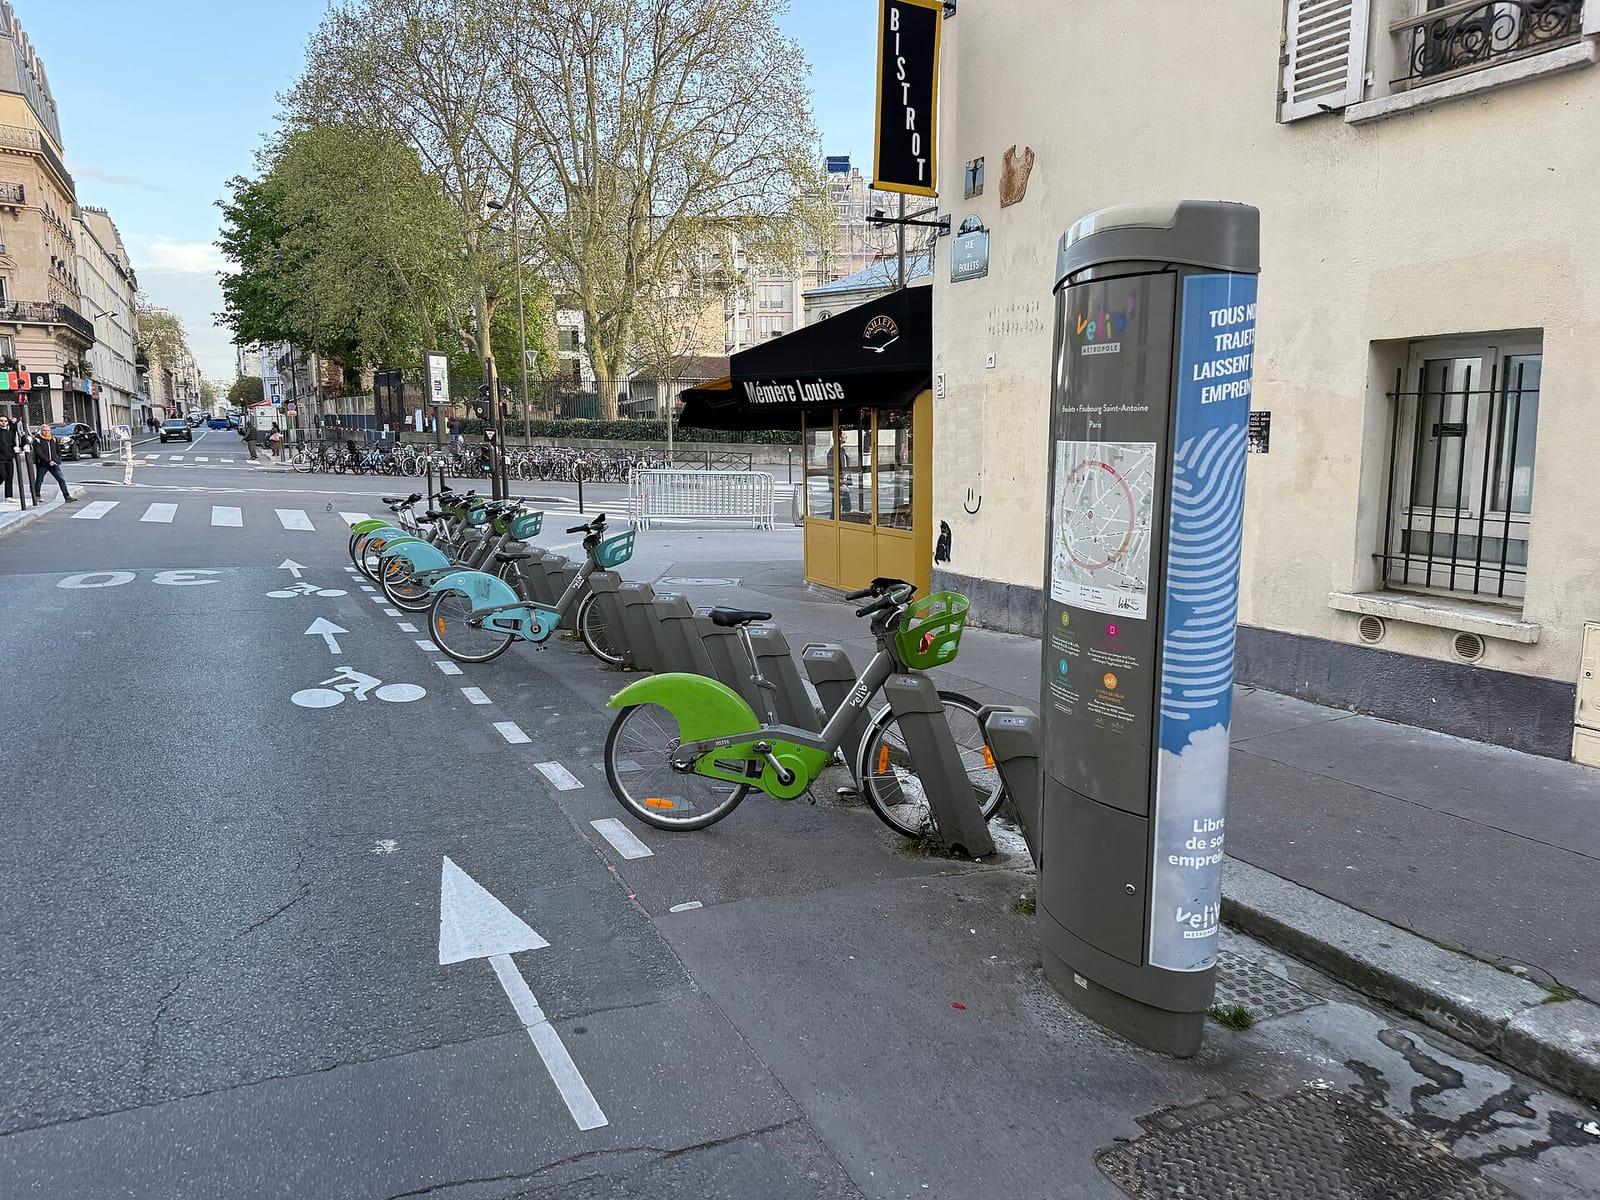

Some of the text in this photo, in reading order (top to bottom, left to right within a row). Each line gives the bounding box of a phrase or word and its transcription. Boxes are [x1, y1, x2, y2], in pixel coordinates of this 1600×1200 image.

[890, 7, 926, 181] BISTROT
[958, 260, 980, 273] BOULETS
[1209, 305, 1245, 328] TOUS
[1192, 354, 1250, 381] LAISSENT
[743, 378, 845, 404] Mémère Louise
[1079, 404, 1102, 415] Faubourg
[1102, 403, 1149, 413] Saint-Antoine
[1089, 420, 1102, 429] Paris
[1185, 836, 1207, 850] de
